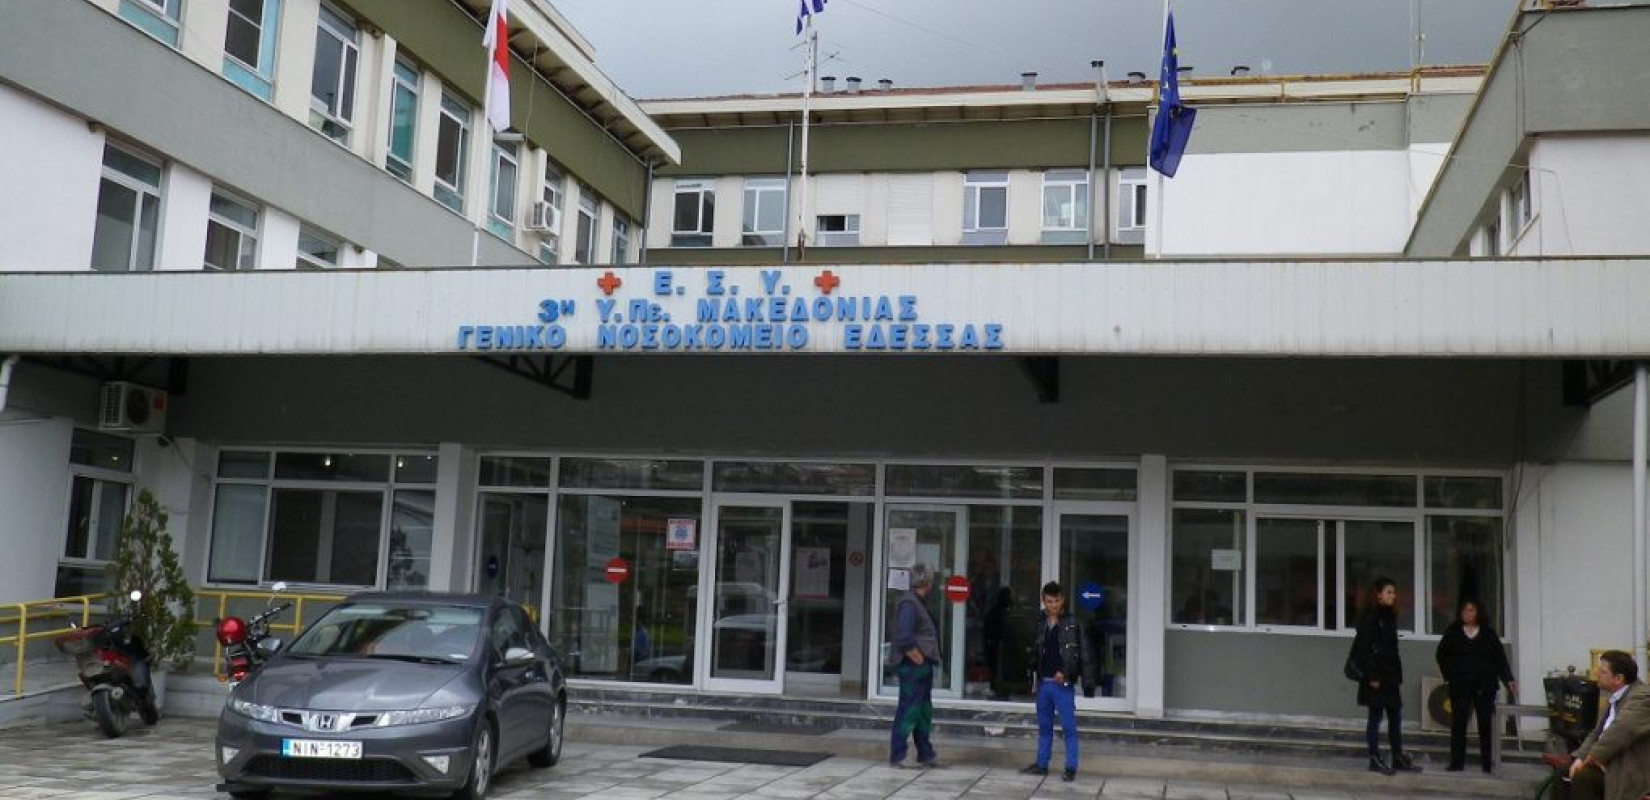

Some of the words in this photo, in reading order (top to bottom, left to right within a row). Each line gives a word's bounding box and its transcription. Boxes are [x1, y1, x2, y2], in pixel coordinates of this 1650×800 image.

[697, 296, 918, 323] ΜΑΚΕΔΟΝΙΑΣ
[457, 325, 567, 350] ΓΕΝΙΚΟ
[597, 324, 810, 350] ΝΟΣΟΚΟΜΕΙΟ
[844, 323, 1004, 350] ΕΔΕΣΣΑΣ
